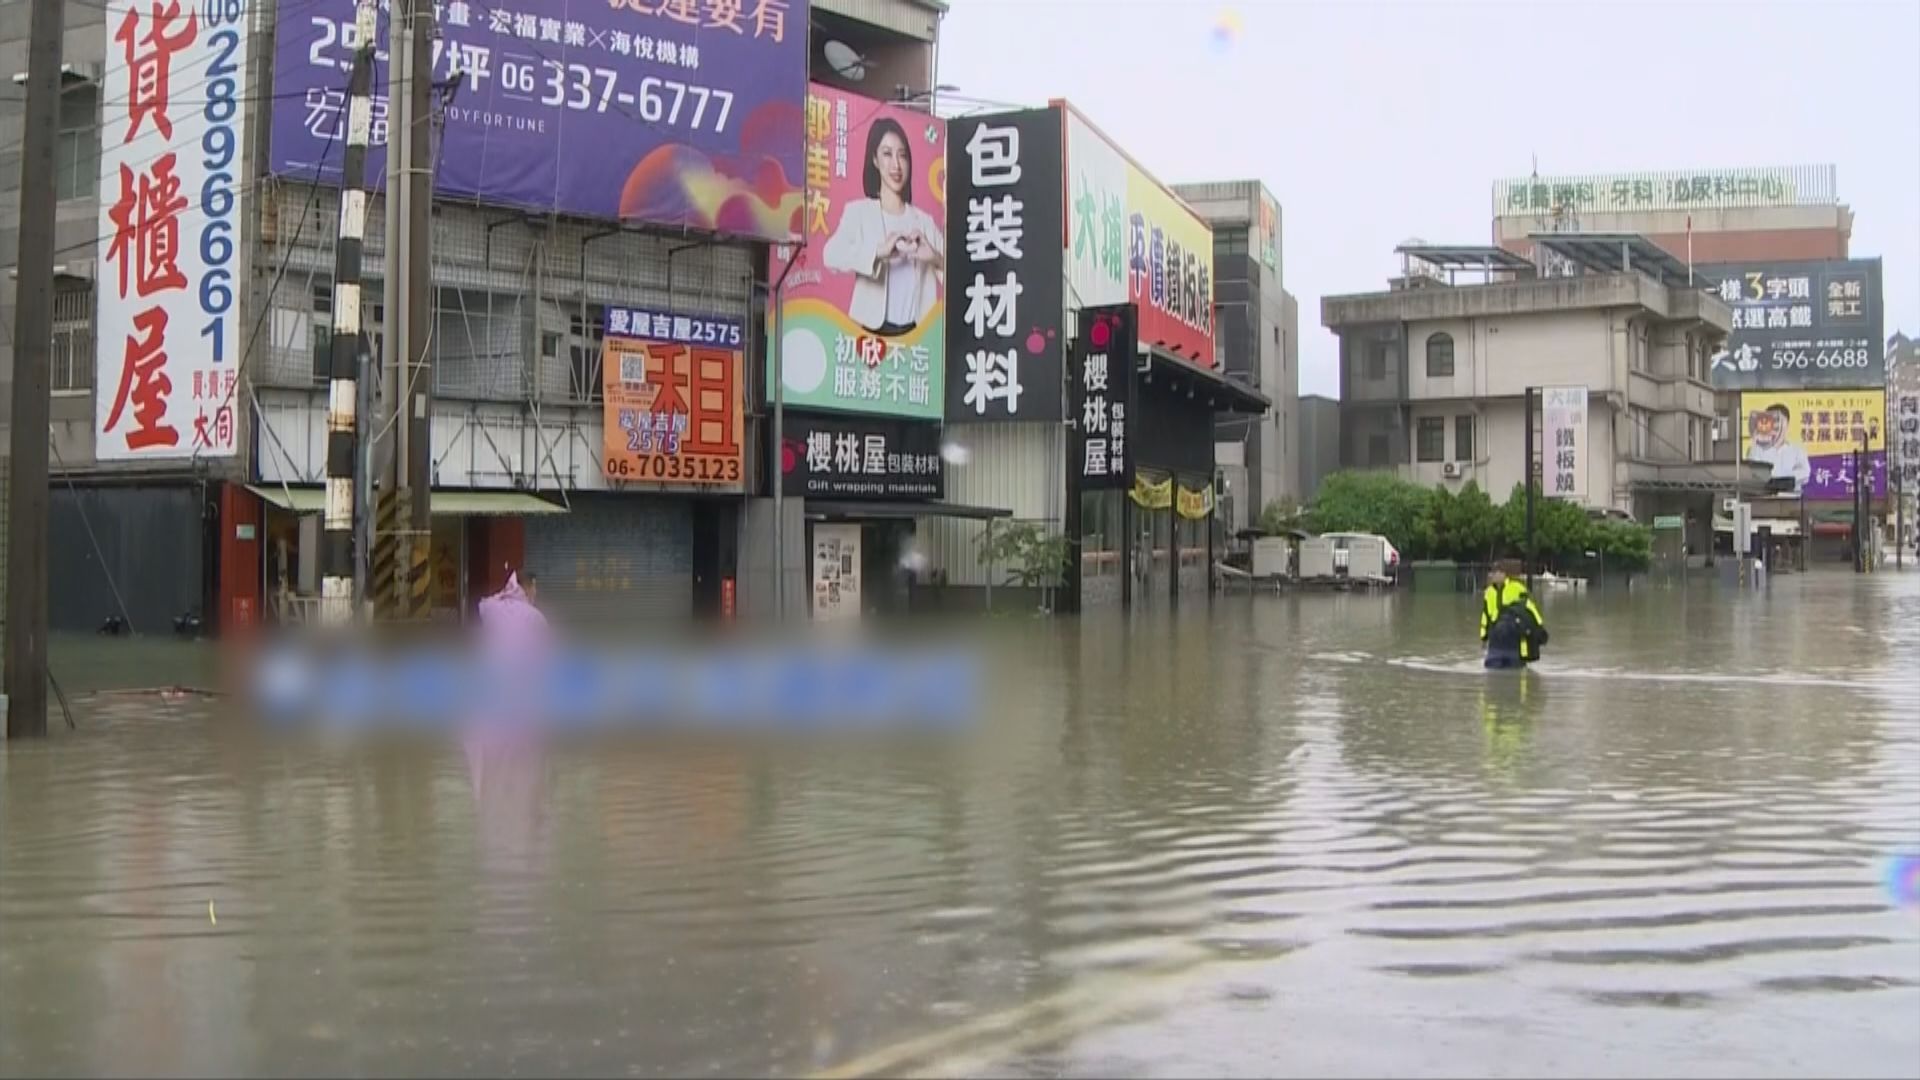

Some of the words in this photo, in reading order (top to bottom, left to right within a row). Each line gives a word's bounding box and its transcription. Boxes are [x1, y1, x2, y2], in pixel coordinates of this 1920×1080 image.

[501, 61, 534, 92] 06
[541, 60, 734, 133] 337-6777
[199, 30, 239, 363] 2896661
[103, 0, 197, 450] 貨櫃屋
[964, 123, 1024, 415] 包裝材料
[1827, 280, 1861, 299] 全新
[1828, 300, 1862, 317] 完工
[609, 309, 741, 346] 愛屋吉屋2575
[835, 332, 929, 372] 初欣不忘
[1771, 349, 1869, 370] 596-6688
[646, 343, 740, 456] 租
[834, 367, 929, 405] 服務不斷
[192, 405, 233, 448] 大同
[1083, 353, 1108, 476] 櫻桃屋
[627, 431, 680, 453] 2575
[806, 430, 886, 474] 櫻桃屋
[888, 454, 939, 475] 包裝材料
[607, 454, 740, 480] 06-7035123
[807, 480, 829, 490] Gift
[833, 482, 884, 494] wrapping
[889, 484, 936, 494] materials
